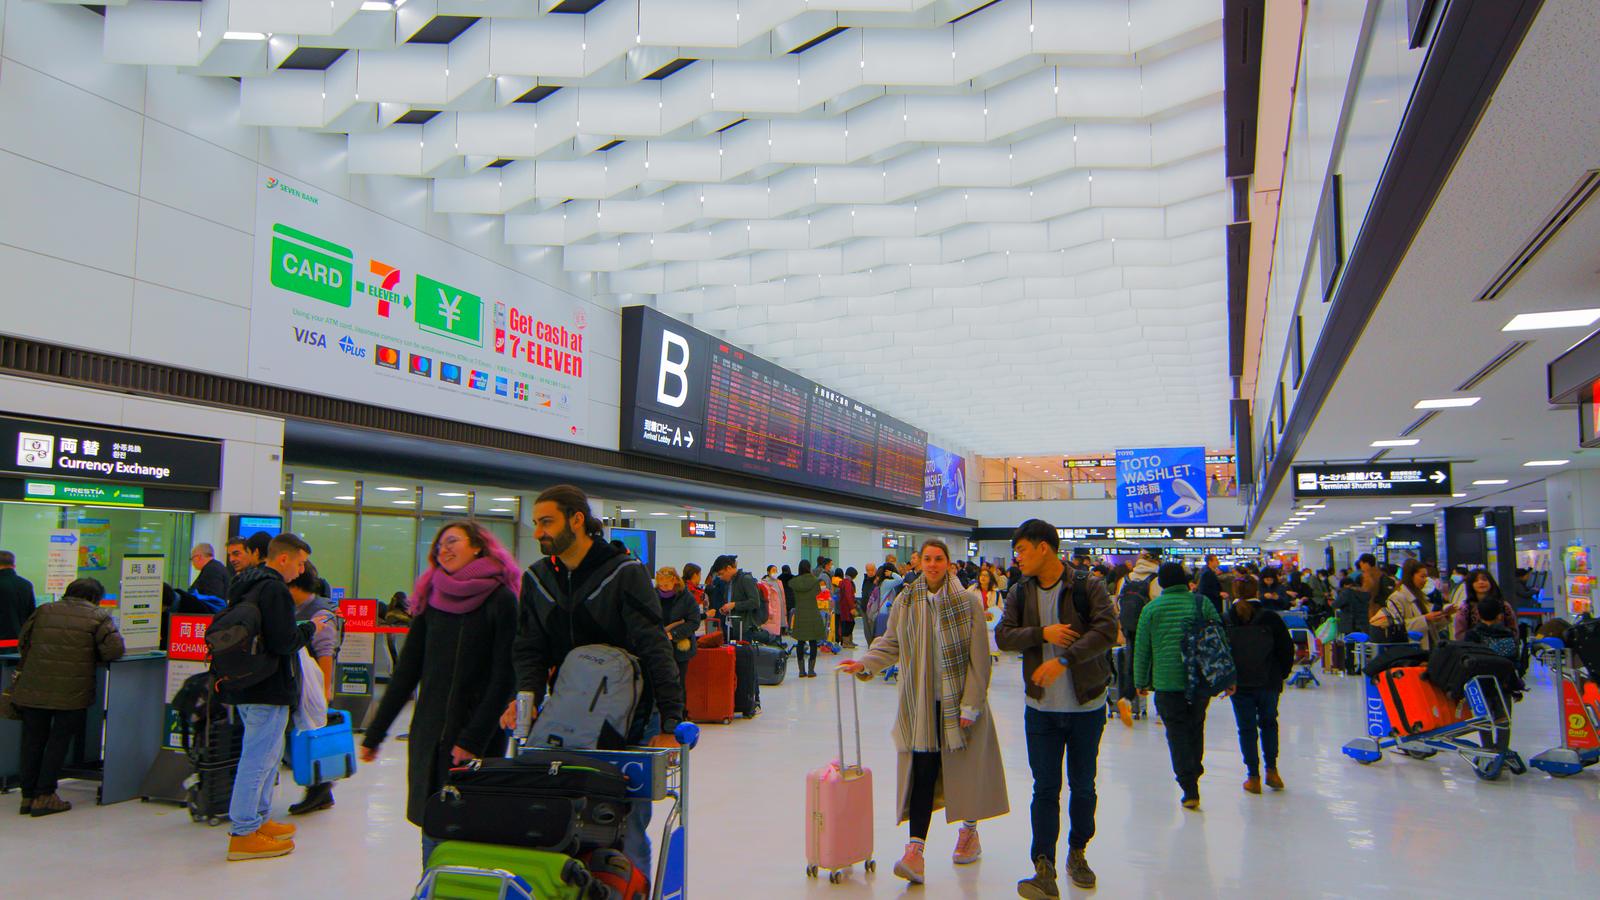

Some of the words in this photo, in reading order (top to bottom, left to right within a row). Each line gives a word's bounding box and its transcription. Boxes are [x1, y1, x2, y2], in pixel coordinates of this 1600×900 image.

[280, 184, 300, 197] SEVEN
[301, 191, 319, 205] BANK
[282, 253, 343, 288] CARD
[292, 326, 327, 349] VISA
[509, 307, 533, 336] Get
[536, 320, 568, 348] cash
[570, 333, 582, 353] at
[345, 345, 366, 358] PLUS
[656, 329, 690, 408] B
[60, 437, 100, 456] 両替
[672, 427, 682, 447] A
[58, 456, 114, 475] Currency
[116, 461, 171, 479] Exchange
[1120, 455, 1161, 471] TOTO
[1319, 482, 1351, 490] Terminal
[1352, 482, 1377, 490] Shuttle
[1132, 495, 1162, 514] No.1
[347, 605, 368, 617] 両替
[180, 622, 206, 639] 両替
[171, 642, 208, 654] EXCHANG
[1368, 697, 1384, 737] DHC
